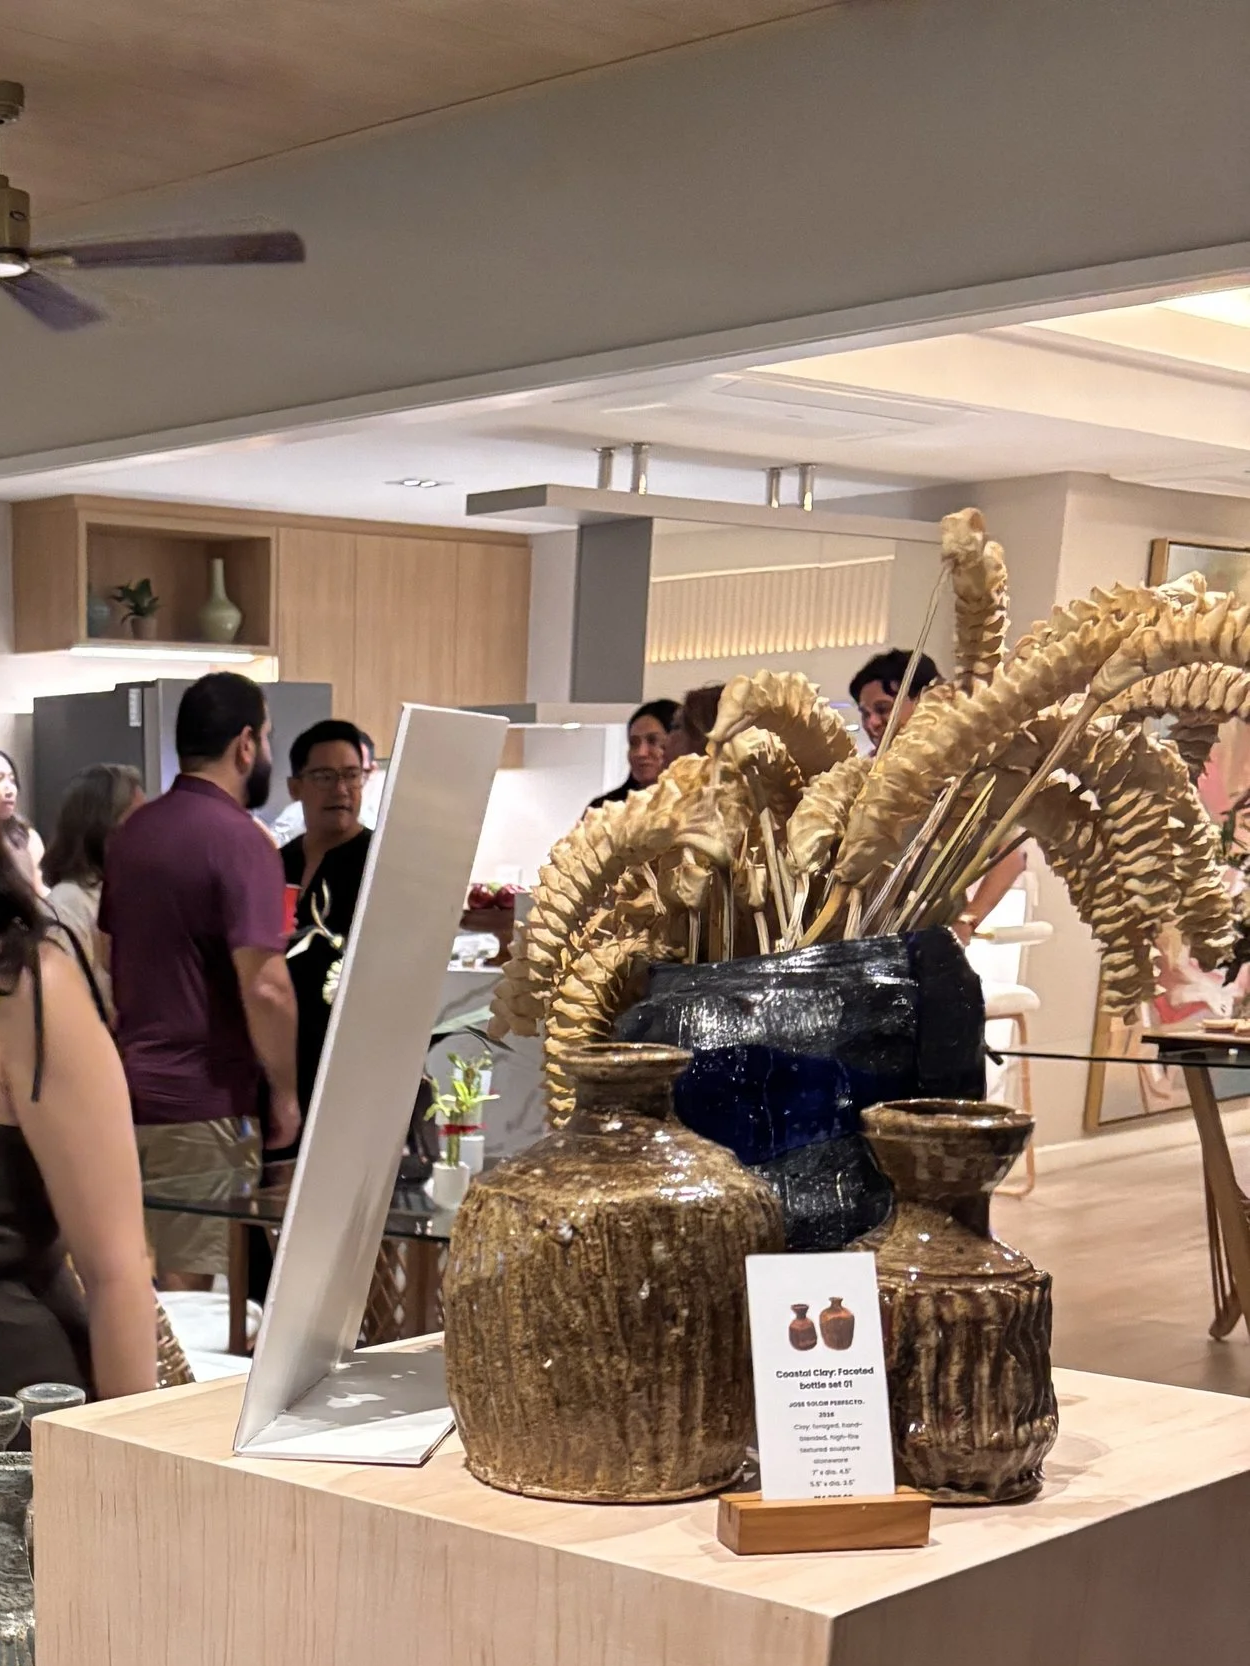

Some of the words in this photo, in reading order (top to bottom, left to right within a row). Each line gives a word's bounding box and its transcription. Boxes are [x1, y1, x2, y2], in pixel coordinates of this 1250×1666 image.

[776, 1369, 811, 1379] Coastal
[838, 1367, 874, 1376] Faceted
[800, 1381, 826, 1389] bottle
[828, 1381, 841, 1389] set
[844, 1380, 852, 1388] 01
